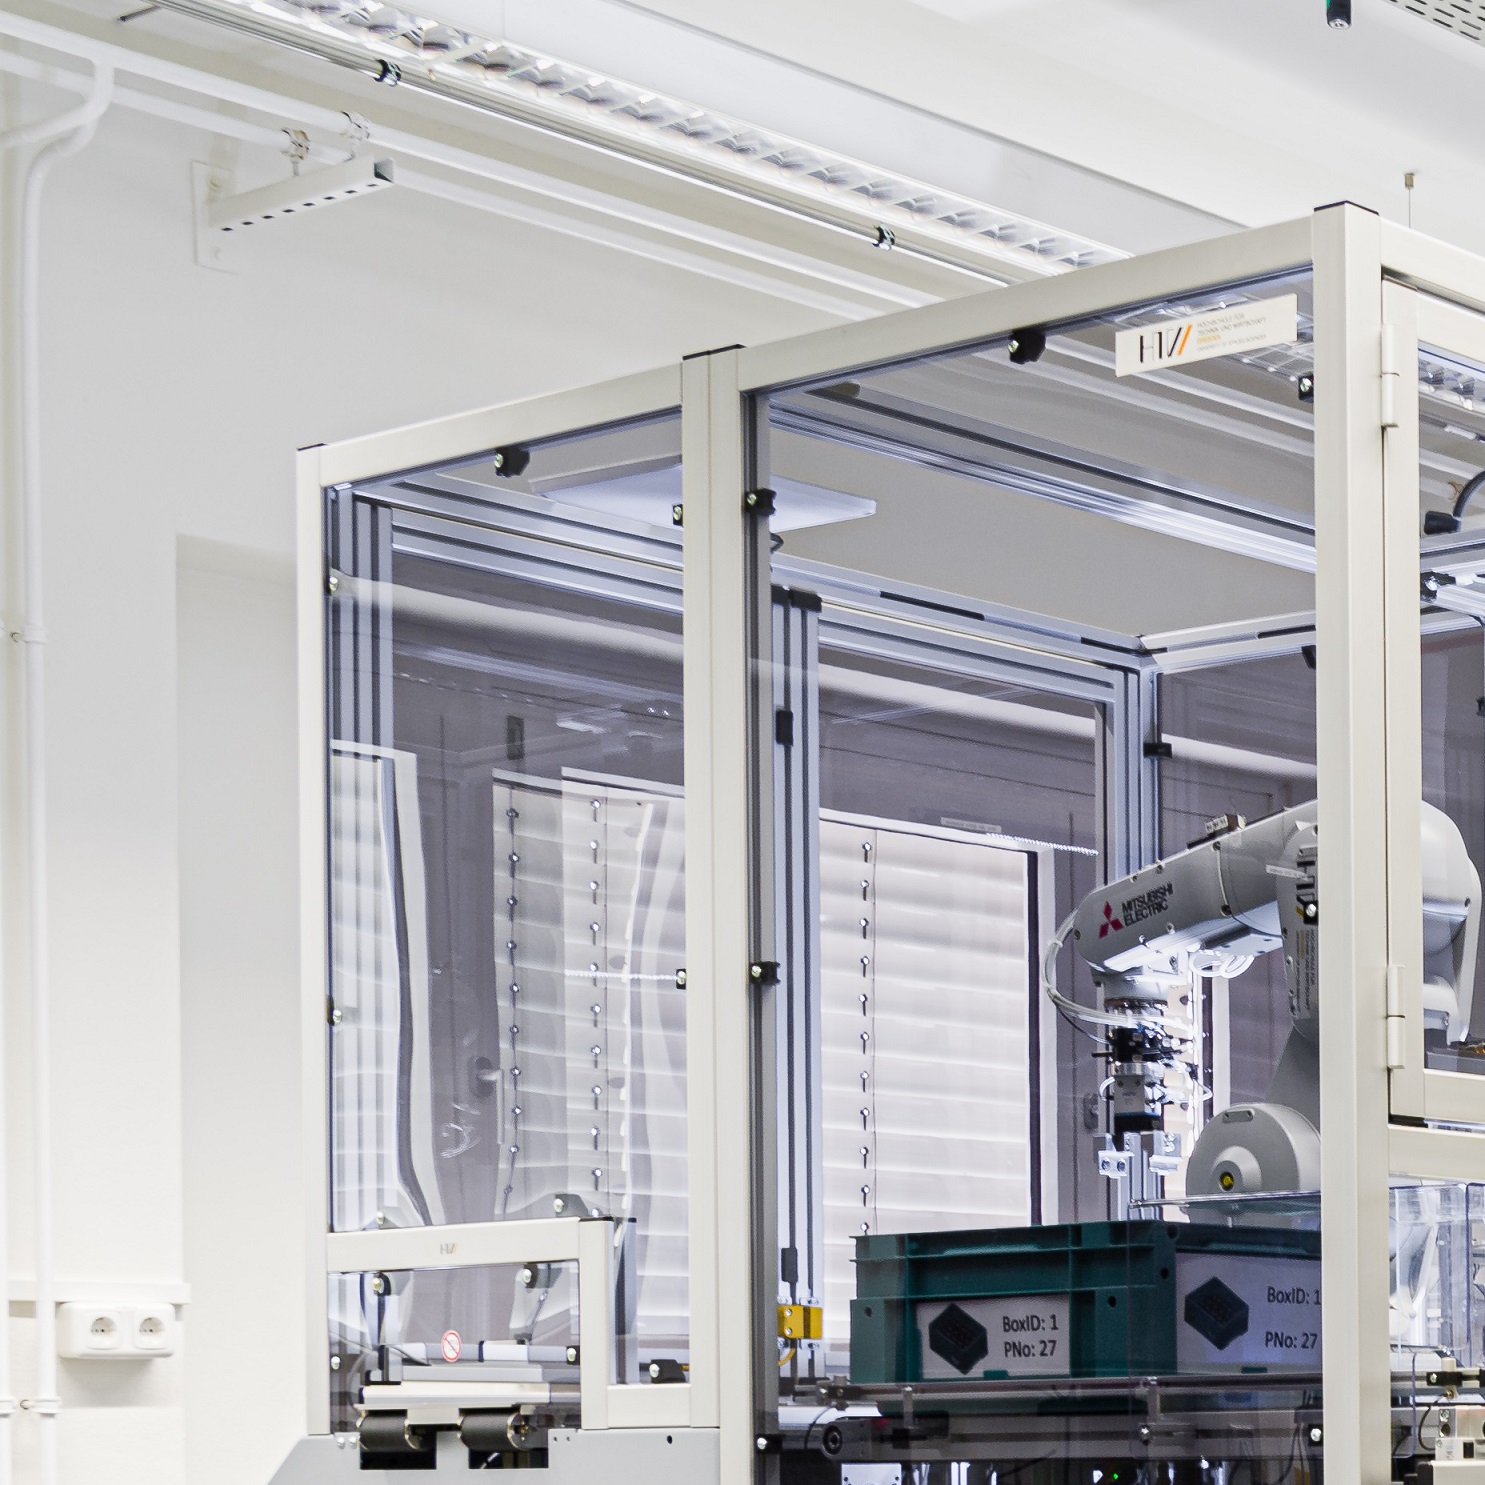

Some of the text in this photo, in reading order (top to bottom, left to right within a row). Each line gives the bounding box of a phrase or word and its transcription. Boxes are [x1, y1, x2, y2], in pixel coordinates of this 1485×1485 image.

[1121, 882, 1173, 913] MITSUBISHI
[1124, 899, 1168, 926] ELECTRIC
[1266, 1286, 1321, 1305] BoxID: 1
[1003, 1314, 1059, 1332] BoxID: 1
[1004, 1340, 1057, 1358] PNo: 27
[1265, 1330, 1318, 1349] PNo: 27
